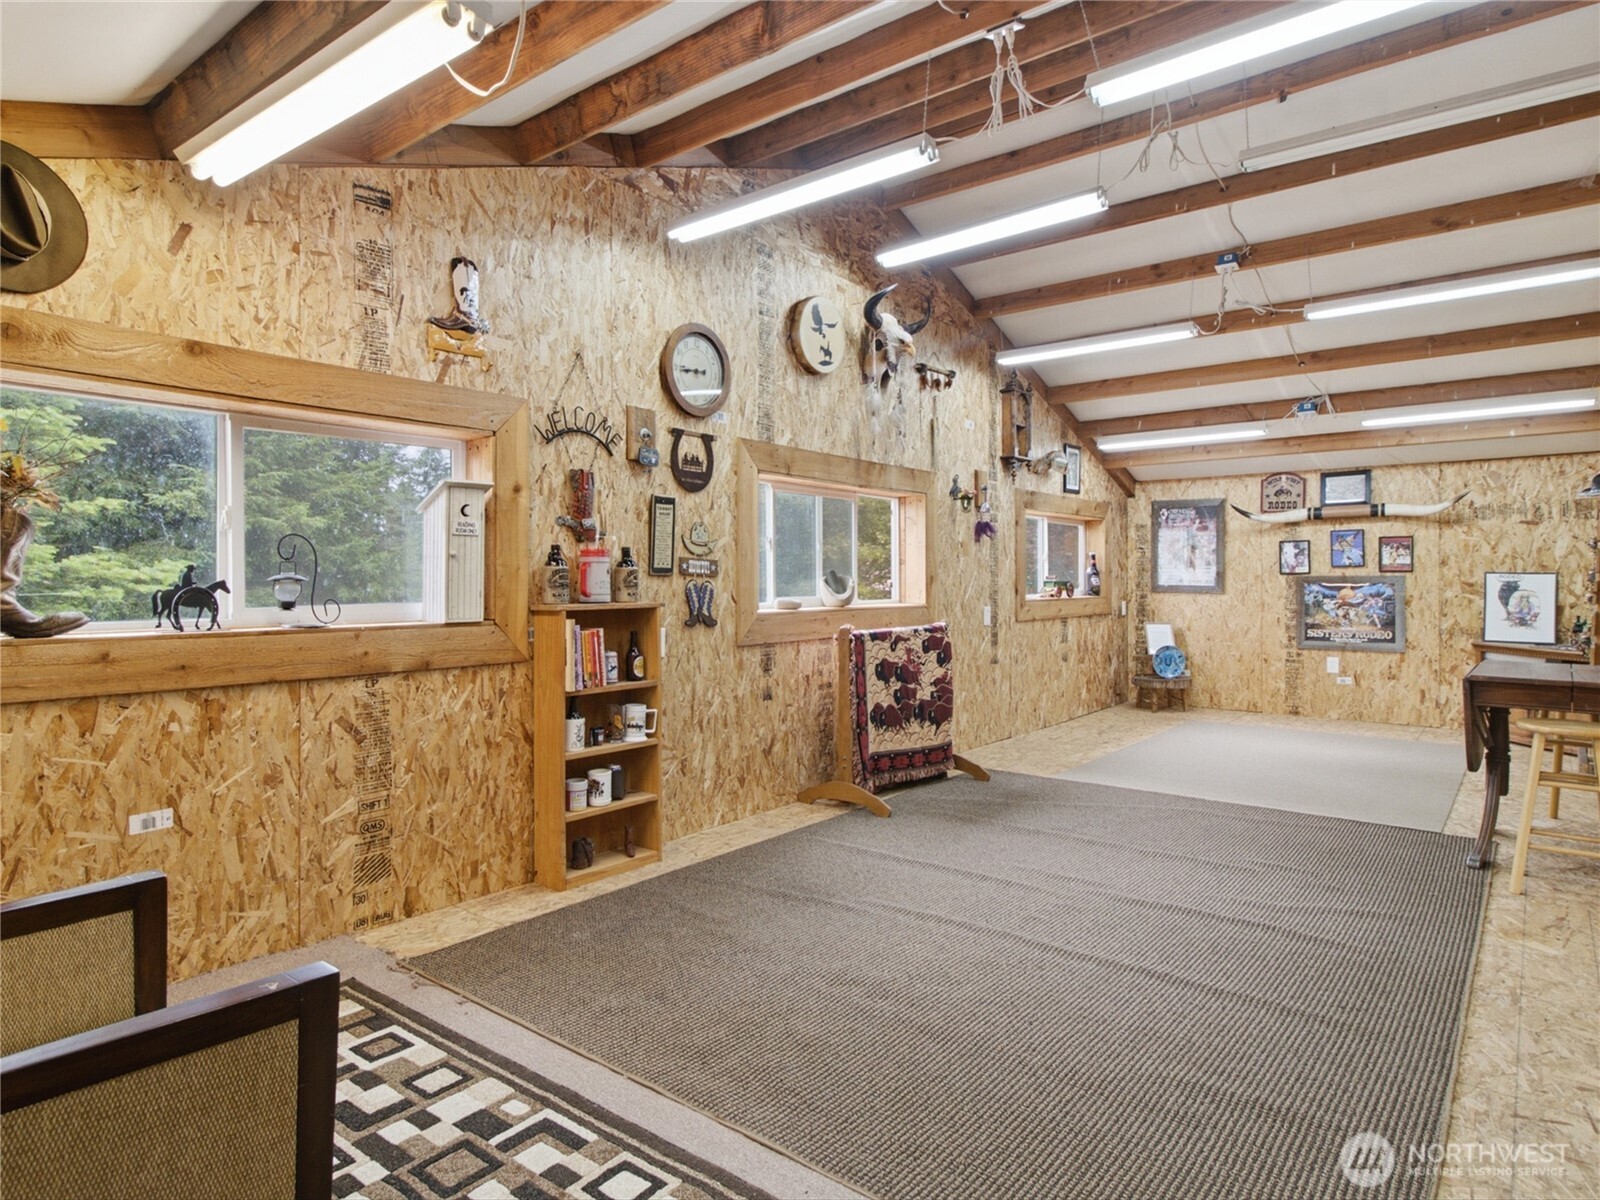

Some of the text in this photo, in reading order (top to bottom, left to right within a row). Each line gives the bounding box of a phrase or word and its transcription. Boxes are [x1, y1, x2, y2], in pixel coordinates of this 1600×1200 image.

[533, 405, 624, 451] WELCOME
[1267, 500, 1298, 510] RODEO
[360, 799, 381, 811] SHIFT
[362, 821, 383, 833] QMS
[355, 894, 366, 905] 30
